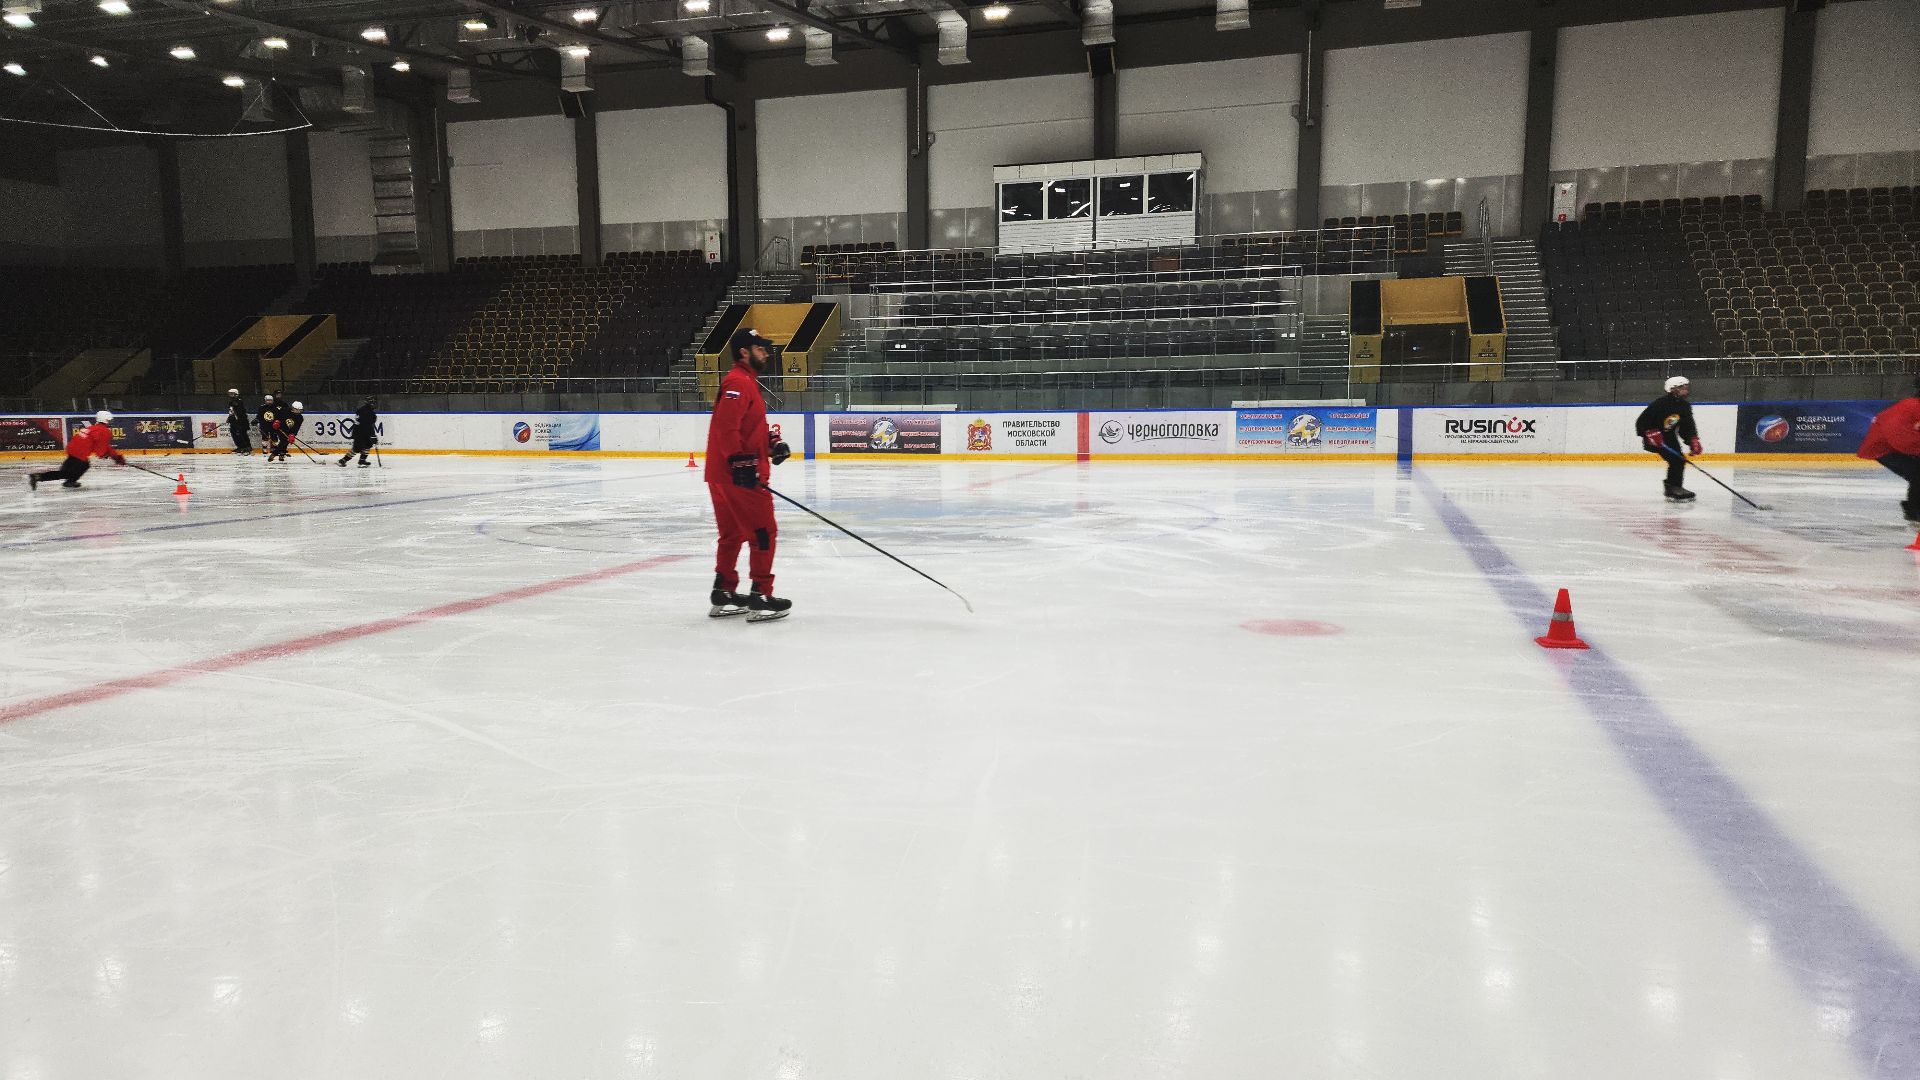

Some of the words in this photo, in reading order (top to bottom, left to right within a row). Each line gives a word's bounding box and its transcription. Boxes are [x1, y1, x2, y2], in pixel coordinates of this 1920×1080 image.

[1795, 415, 1846, 423] ФЕДЕРАЦИЯ
[1002, 420, 1060, 428] ПРАВИТЕЛЬСТВО
[1445, 416, 1536, 434] RUSINOX
[1795, 423, 1827, 431] ХОККЕЯ
[1007, 428, 1056, 437] МОСКОВСКОЙ
[1015, 439, 1047, 447] ОБЛАСТИ
